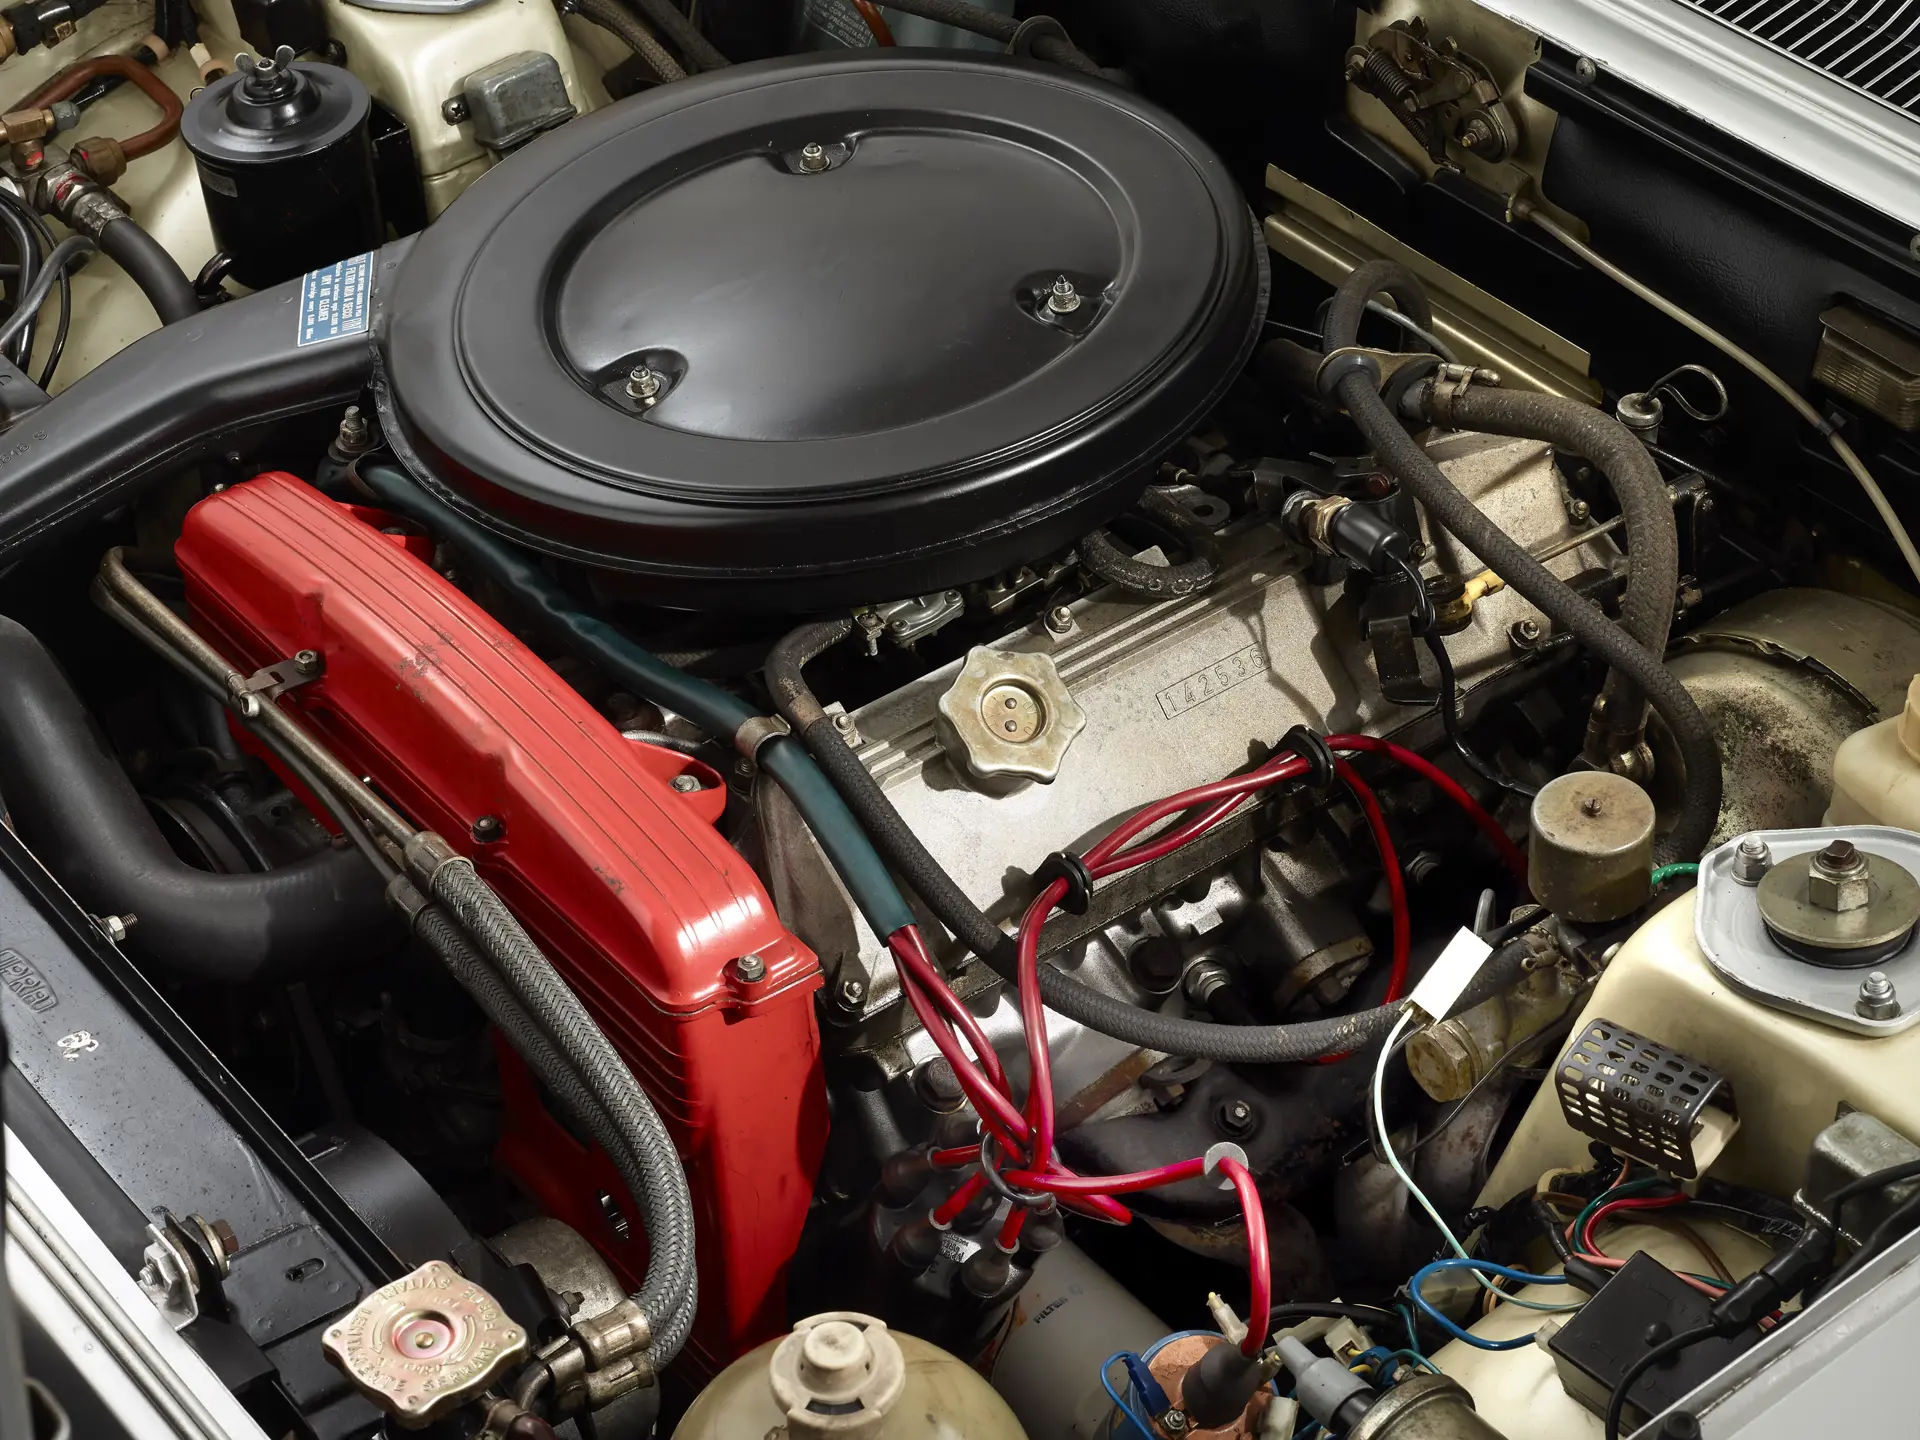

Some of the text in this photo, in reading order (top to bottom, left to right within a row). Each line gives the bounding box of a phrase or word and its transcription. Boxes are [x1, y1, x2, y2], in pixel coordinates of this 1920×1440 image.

[343, 285, 355, 297] ARIA
[345, 266, 356, 285] FILTRO
[318, 274, 332, 322] DRY AIR CLEANER
[342, 302, 354, 319] SECCO
[1164, 647, 1265, 712] 142536
[375, 1275, 453, 1306] SVITARE
[347, 1307, 408, 1392] LENTAMENTE
[422, 1338, 496, 1392] SERRARE
[463, 1285, 498, 1332] FORTE
